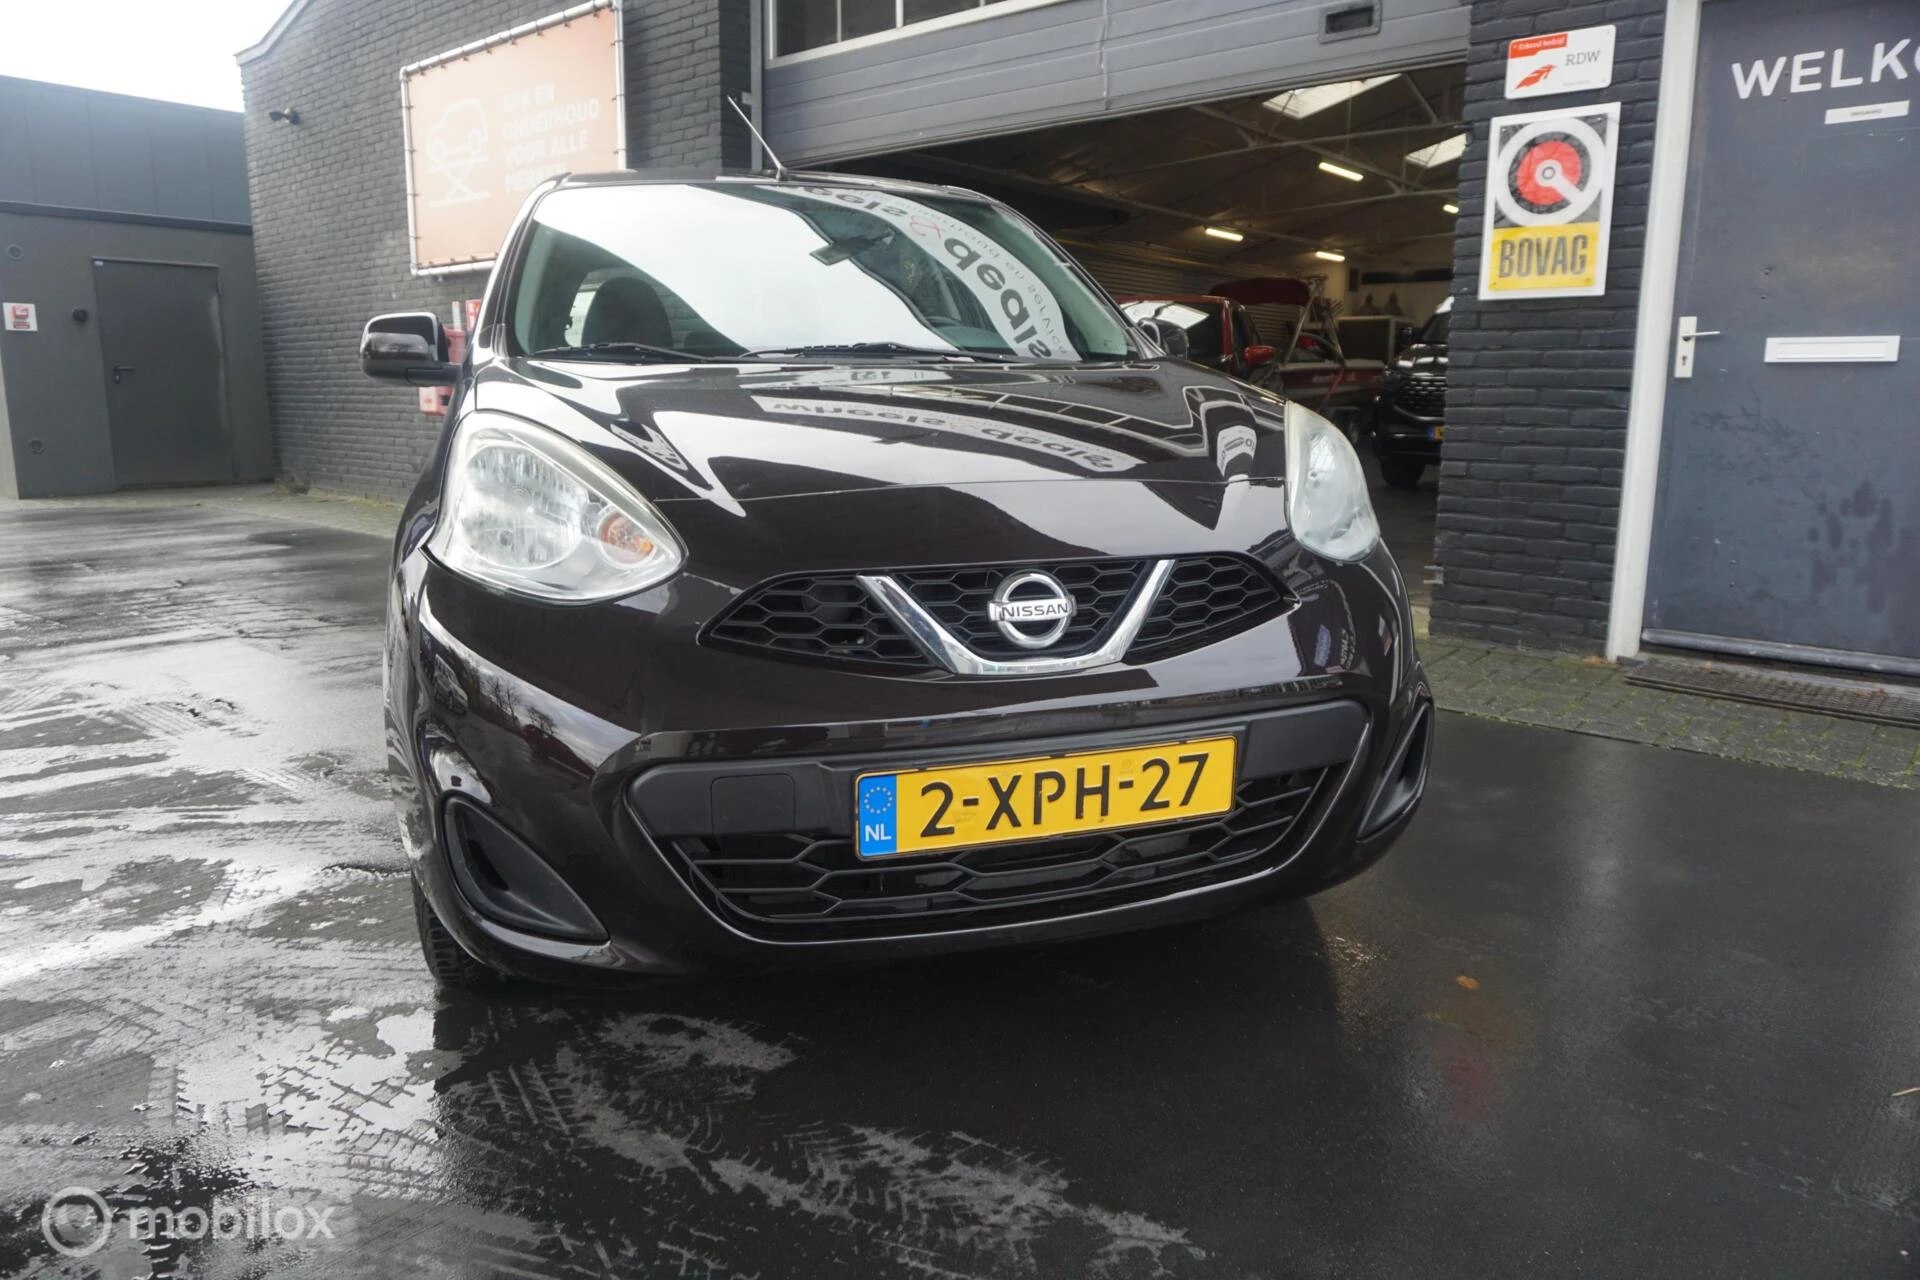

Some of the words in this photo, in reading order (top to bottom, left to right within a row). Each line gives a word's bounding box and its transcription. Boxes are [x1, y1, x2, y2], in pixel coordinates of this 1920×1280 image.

[1565, 50, 1600, 66] RDW
[551, 129, 589, 157] ALLE
[1498, 234, 1588, 278] BOVAG
[1001, 603, 1068, 617] NISSAN
[920, 753, 1209, 838] 2-XPH-27
[865, 823, 892, 843] NL
